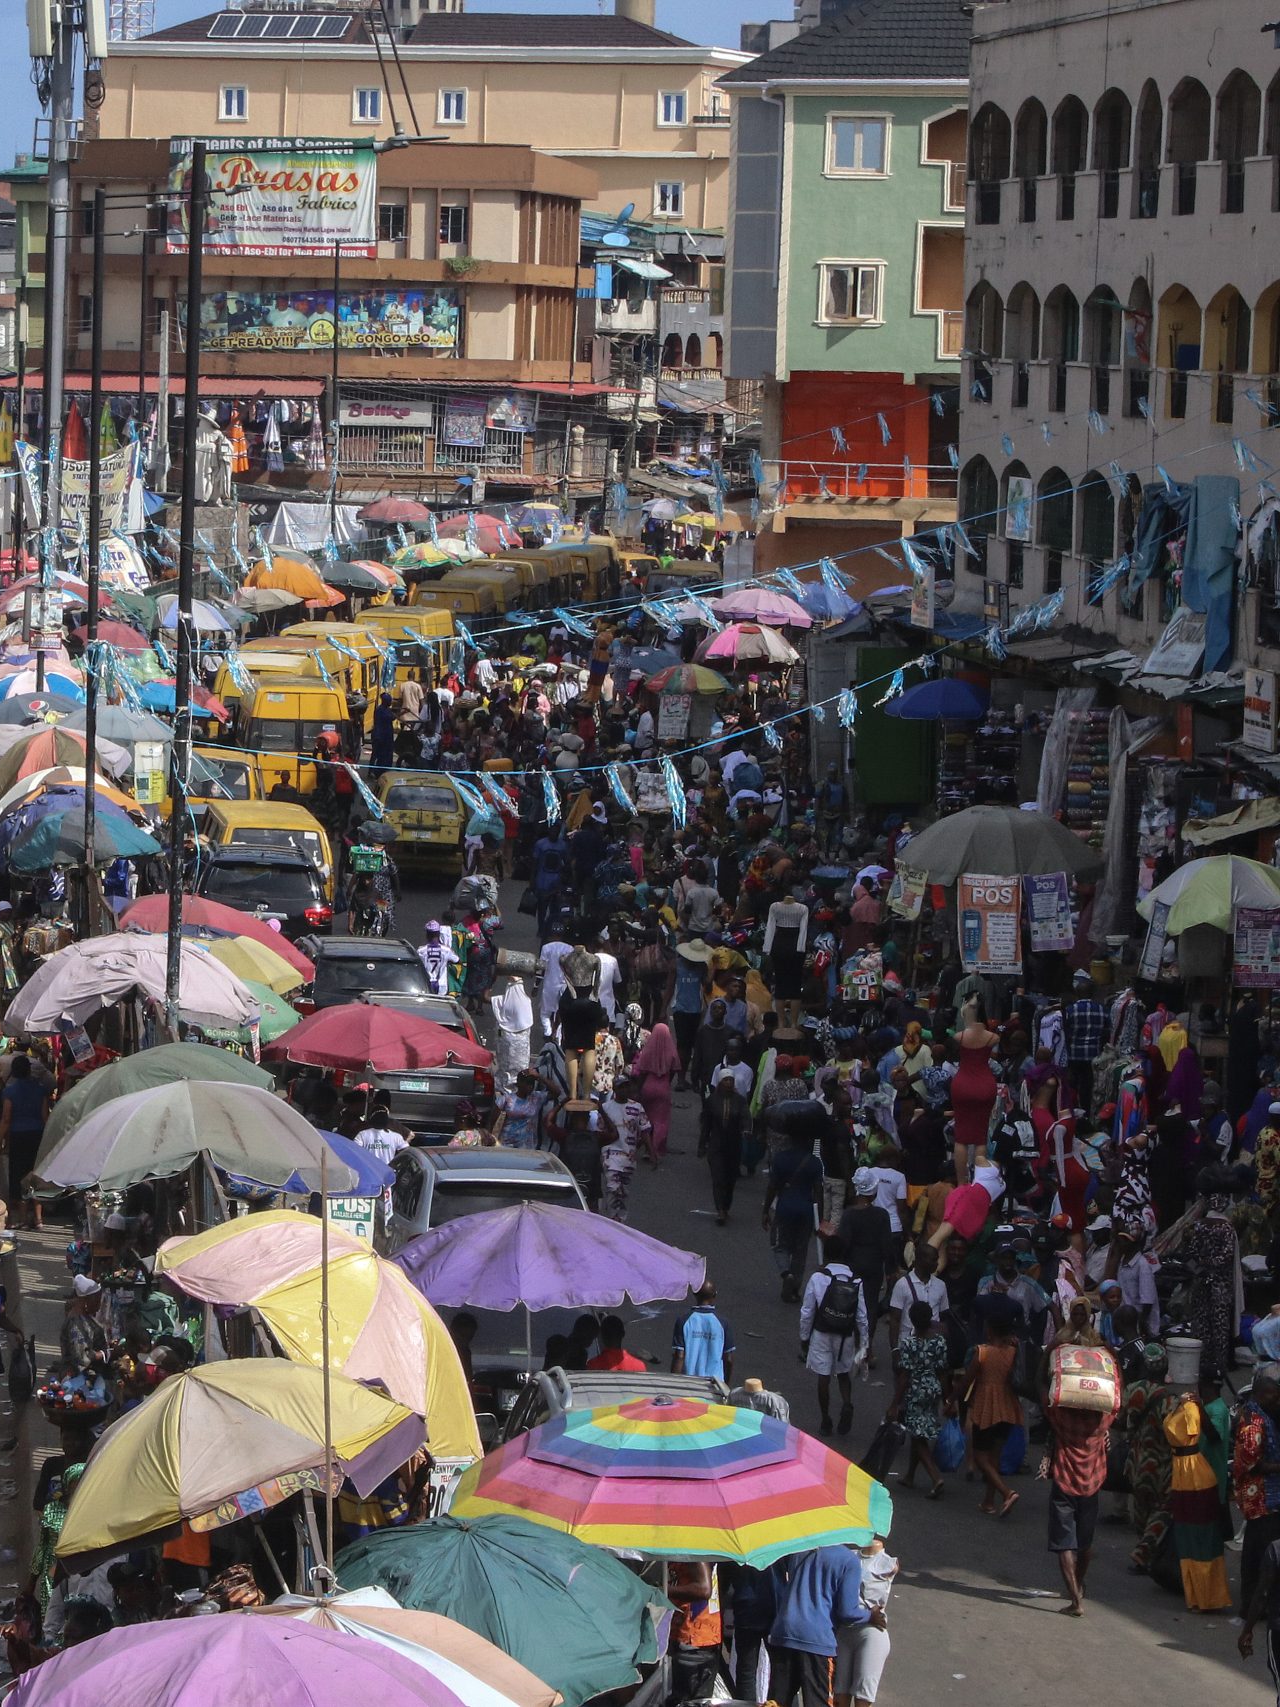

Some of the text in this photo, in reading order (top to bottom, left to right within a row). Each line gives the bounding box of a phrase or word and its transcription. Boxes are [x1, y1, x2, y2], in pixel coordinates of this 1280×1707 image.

[216, 156, 359, 194] Prasas
[297, 195, 358, 211] Fabrics
[220, 204, 235, 212] Aso
[278, 205, 293, 213] oke
[264, 214, 302, 222] Materials
[245, 247, 279, 256] Aso-Ebi
[280, 249, 293, 257] for
[315, 249, 333, 257] and
[356, 334, 401, 343] GONGO
[1038, 881, 1056, 890] POS
[972, 886, 1013, 904] POS
[428, 959, 441, 974] 7
[331, 1198, 371, 1214] POS
[1082, 1380, 1094, 1389] 50
